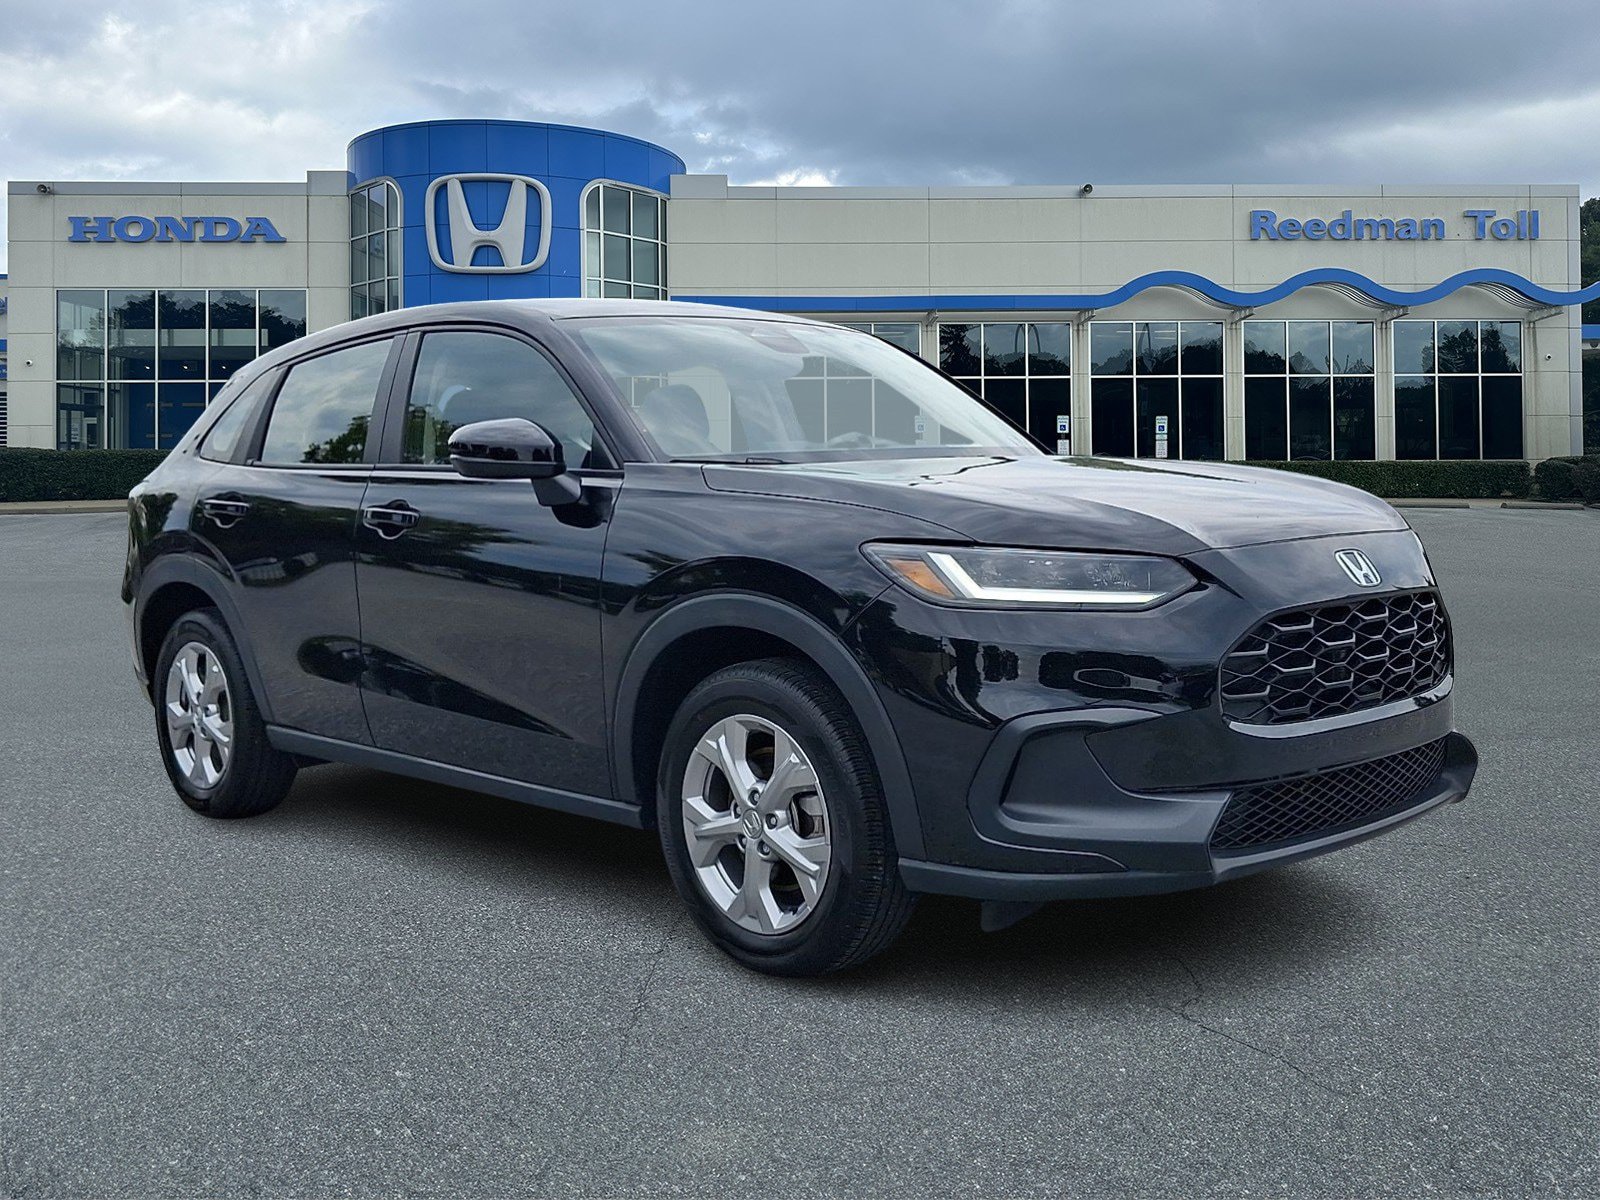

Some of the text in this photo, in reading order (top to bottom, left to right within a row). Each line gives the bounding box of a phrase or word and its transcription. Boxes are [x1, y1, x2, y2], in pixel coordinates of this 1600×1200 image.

[68, 215, 287, 243] HONDA
[1250, 209, 1539, 240] Reedman Toll
